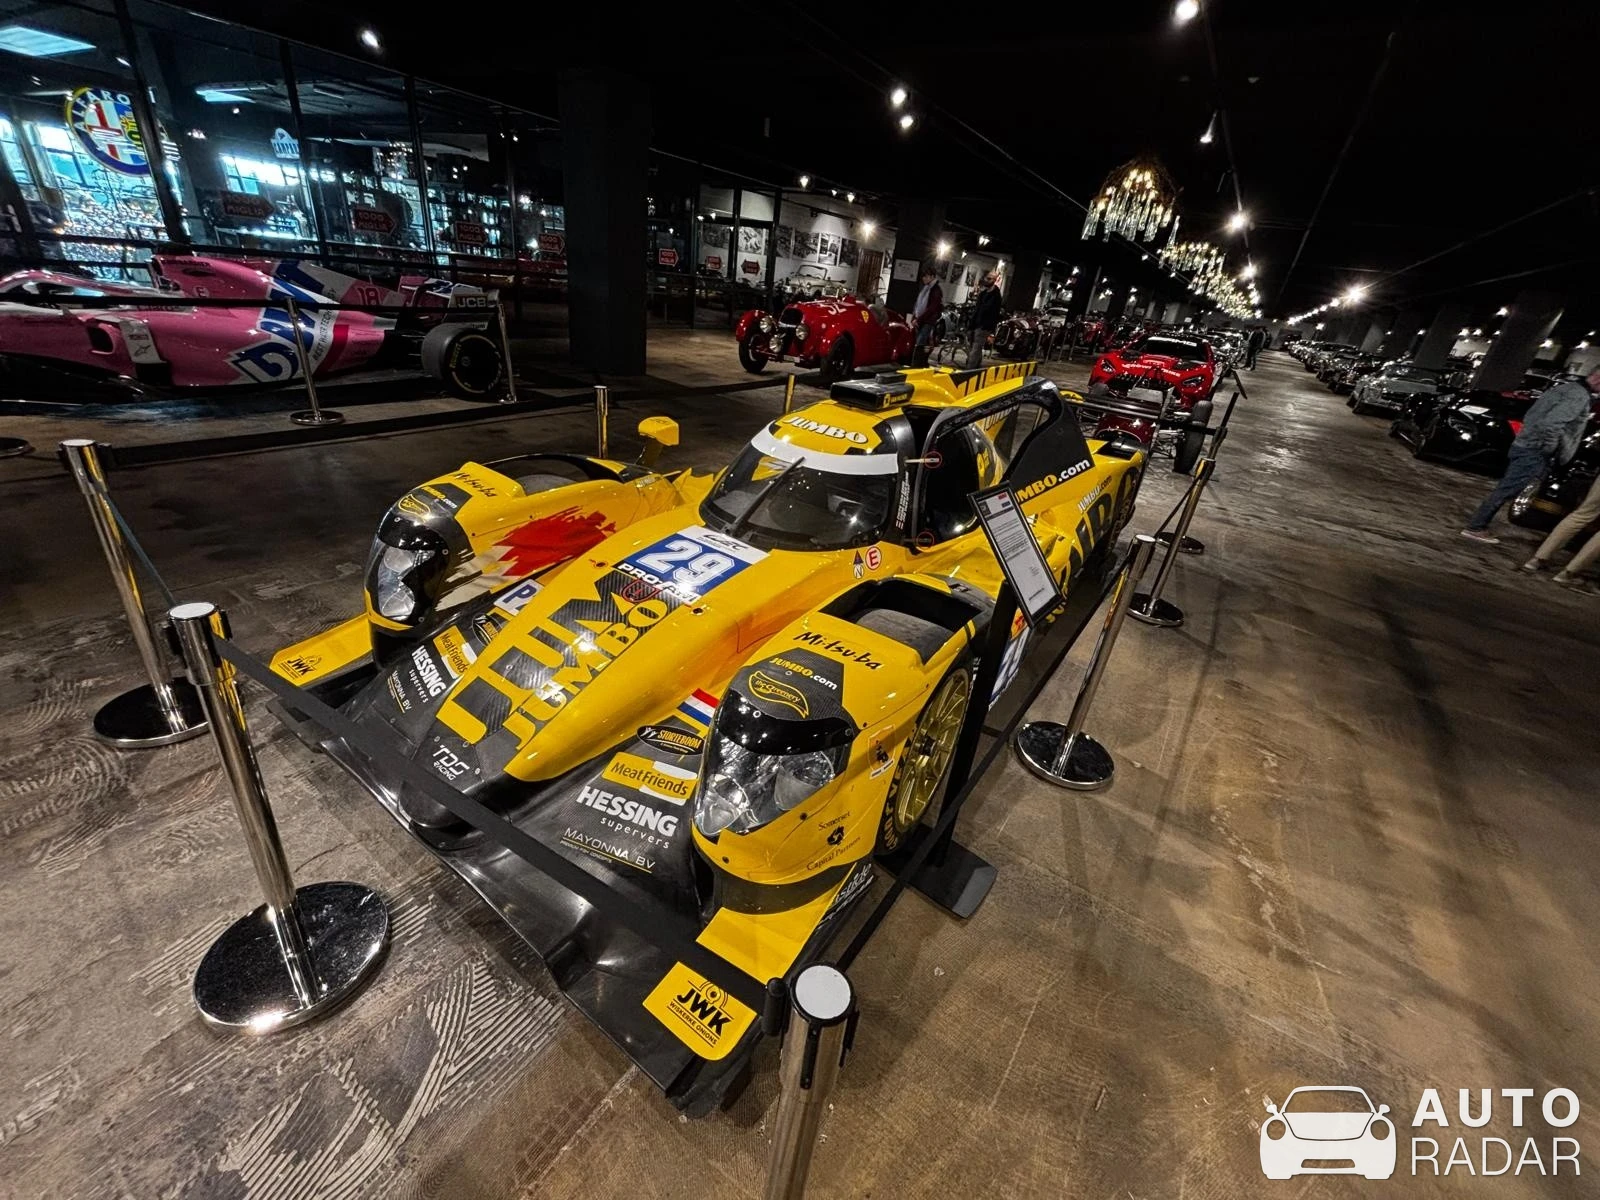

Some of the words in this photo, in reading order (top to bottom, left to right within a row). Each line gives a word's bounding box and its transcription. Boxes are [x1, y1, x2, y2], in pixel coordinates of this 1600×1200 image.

[458, 297, 488, 308] JCB
[783, 416, 869, 444] JUMBO
[635, 539, 736, 588] 29
[287, 658, 315, 676] JWK
[411, 645, 447, 697] HESSING
[769, 657, 838, 691] JUMBO.com
[408, 669, 429, 703] supervers
[658, 729, 702, 749] STORTEBOOM
[433, 760, 457, 781] RACING
[610, 762, 689, 796] MeatFriends
[576, 785, 679, 837] HESSING
[818, 811, 850, 831] Somerset
[564, 827, 629, 860] MAYONNA
[635, 854, 656, 870] BV
[600, 817, 670, 849] supervers
[806, 847, 836, 871] Capital
[835, 836, 861, 857] Partners
[669, 1001, 697, 1029] WISKERKE
[695, 1023, 718, 1046] ONIONS
[676, 988, 731, 1037] JWK
